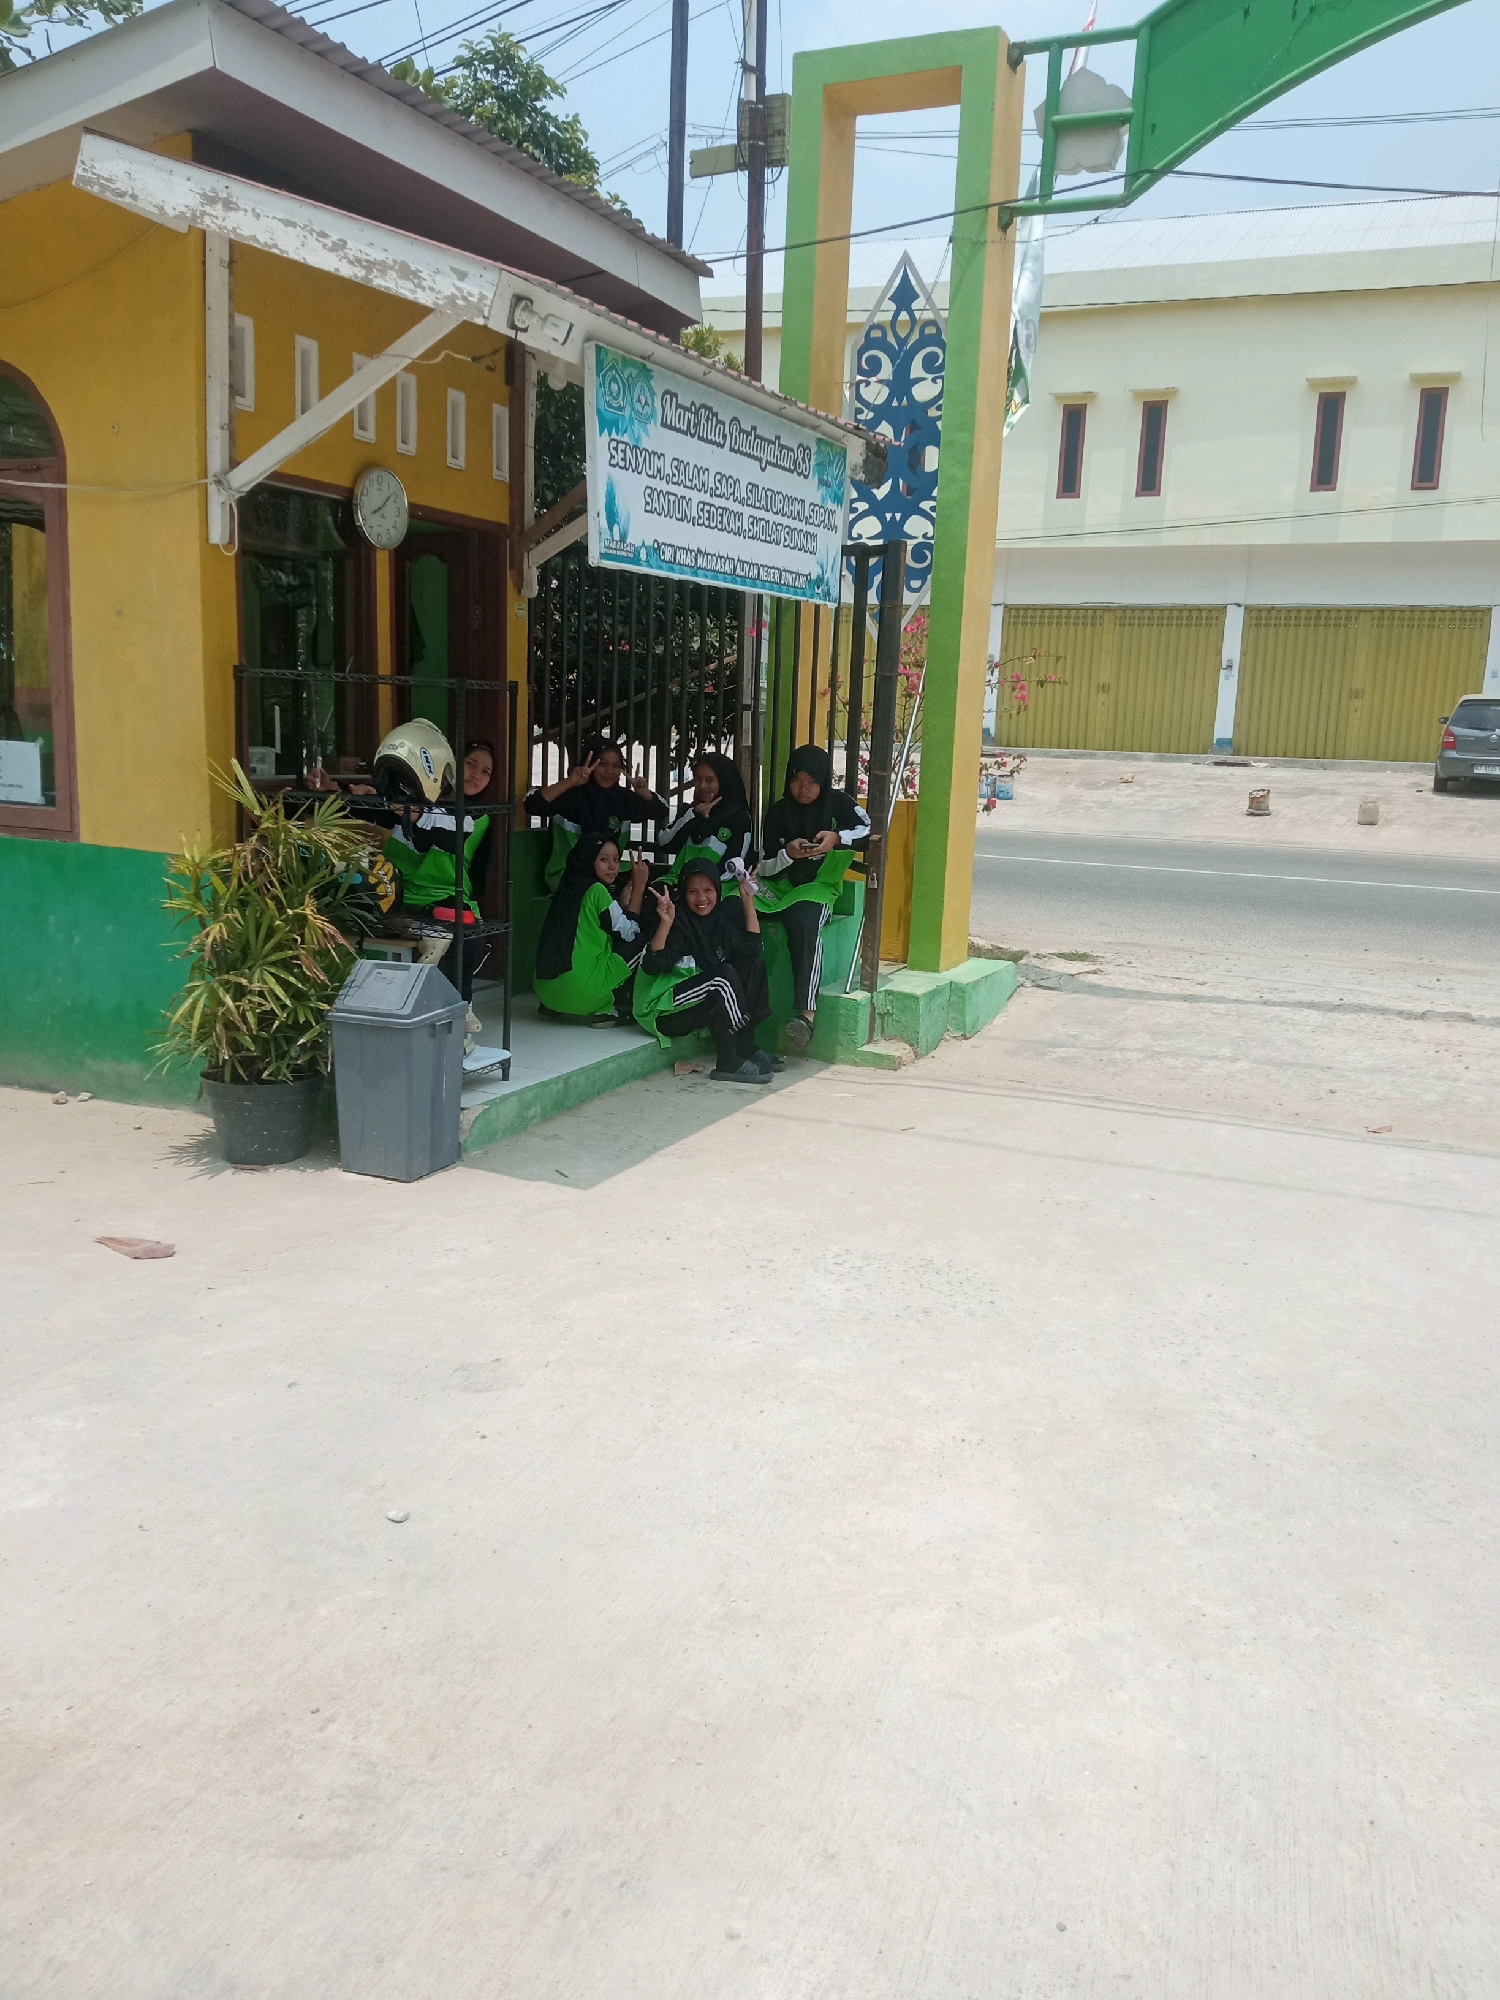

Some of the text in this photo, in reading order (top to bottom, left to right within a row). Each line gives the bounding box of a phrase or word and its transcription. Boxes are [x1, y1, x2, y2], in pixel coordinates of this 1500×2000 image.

[660, 389, 697, 438] Mari
[697, 403, 728, 449] Kita
[729, 416, 795, 474] Budayakan
[747, 515, 783, 546] SHOLAT
[783, 525, 818, 555] SUNNAH
[675, 546, 697, 568] KHAS
[697, 550, 735, 576] MADRASAH
[735, 557, 760, 580] ALIYAH
